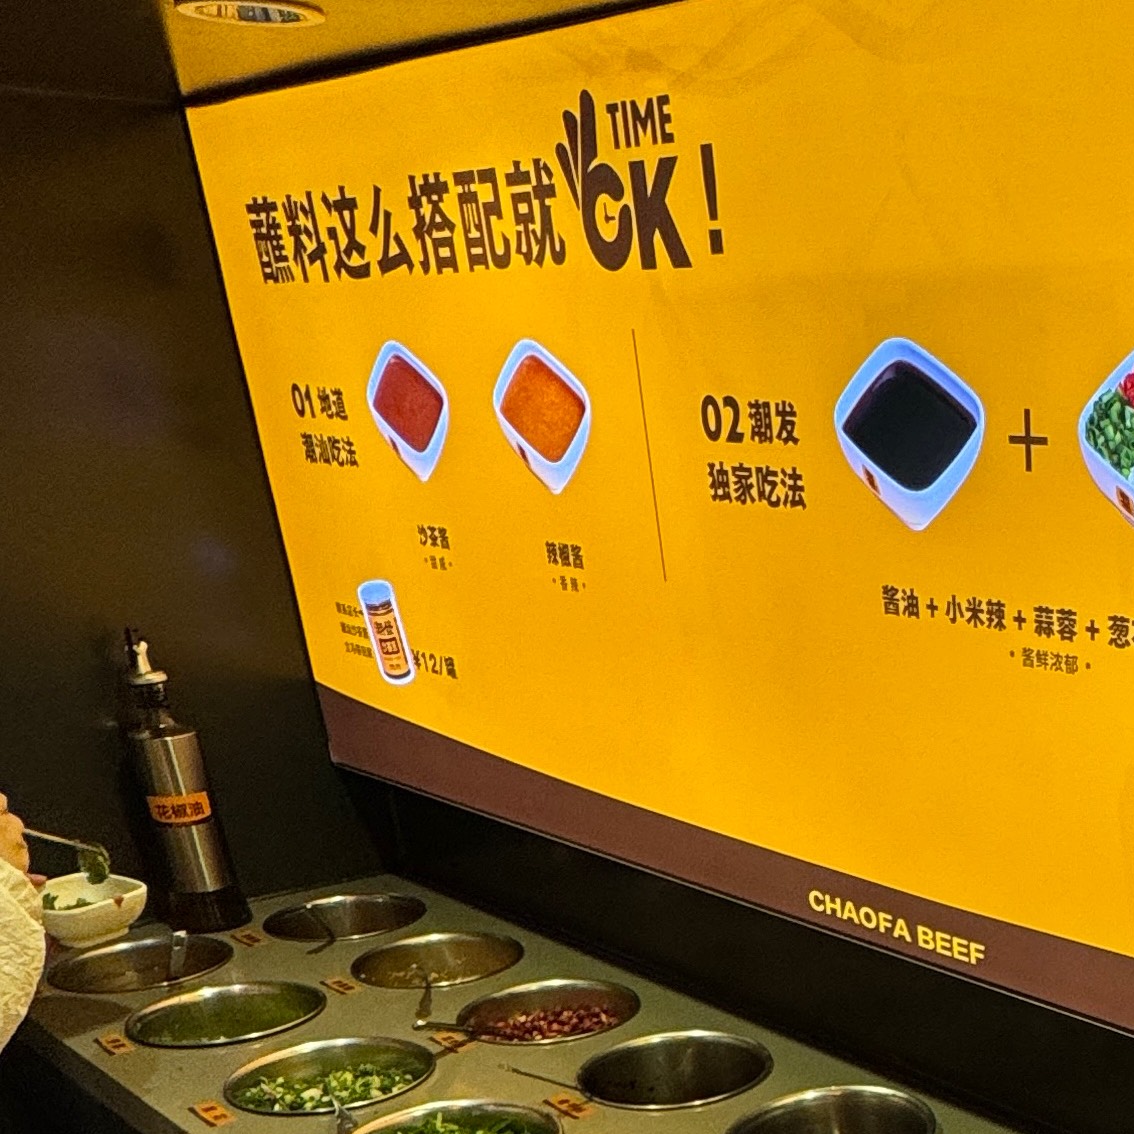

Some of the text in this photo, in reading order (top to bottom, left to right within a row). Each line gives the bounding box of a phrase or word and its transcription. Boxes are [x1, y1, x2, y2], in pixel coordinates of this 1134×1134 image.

[606, 94, 675, 149] TIME
[245, 157, 566, 284] 蘸料这么搭配就
[291, 383, 317, 419] 01
[701, 395, 800, 446] 02 潮发
[706, 462, 807, 511] 独家吃法
[808, 889, 986, 966] CHAOFA BEEF
